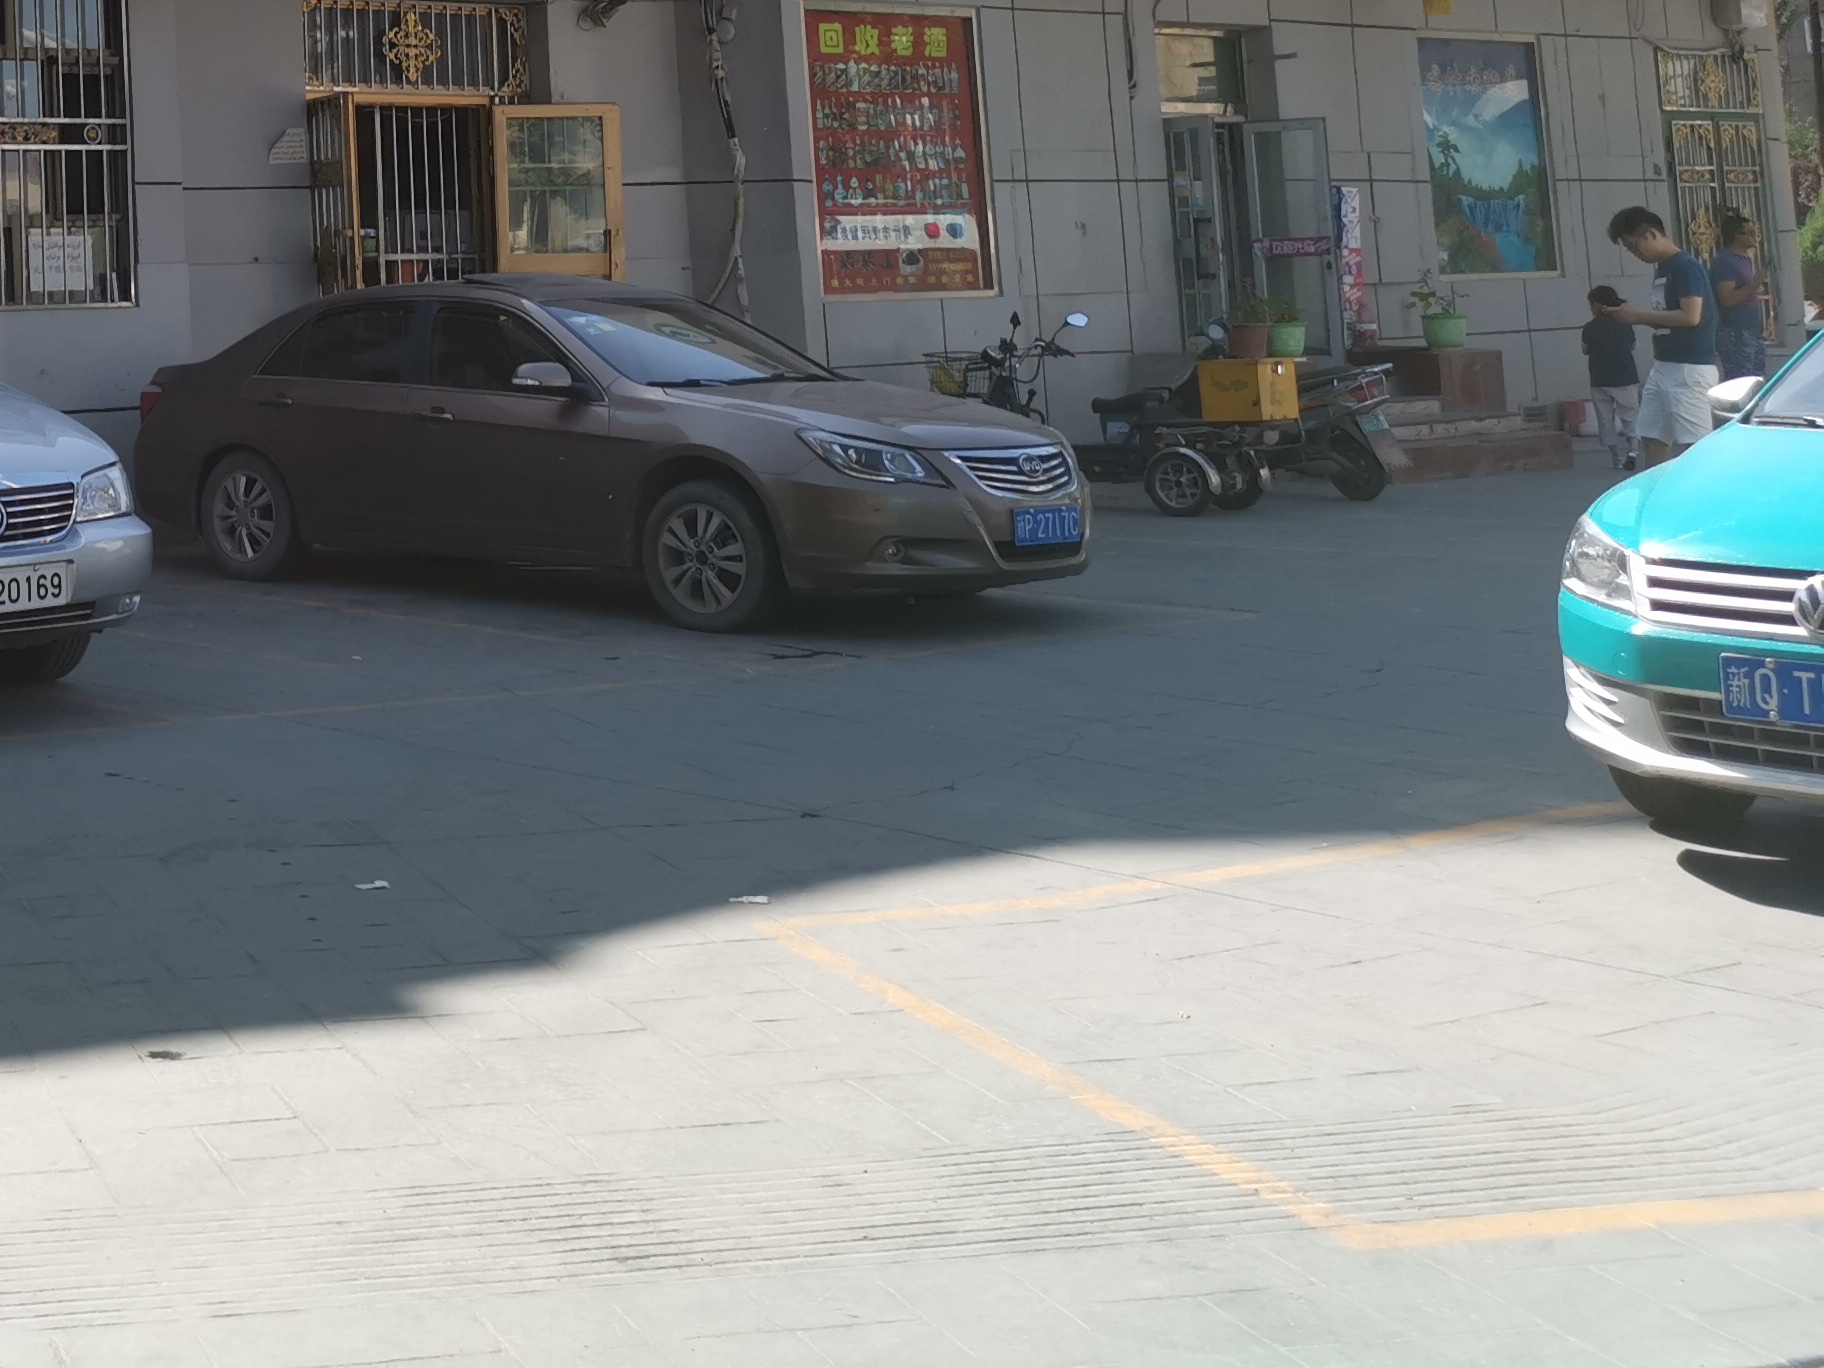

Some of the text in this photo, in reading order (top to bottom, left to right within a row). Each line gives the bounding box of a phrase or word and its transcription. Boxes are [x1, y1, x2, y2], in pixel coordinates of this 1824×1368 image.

[818, 23, 948, 58] 回收老酒
[1726, 665, 1824, 715] 新Q·T
